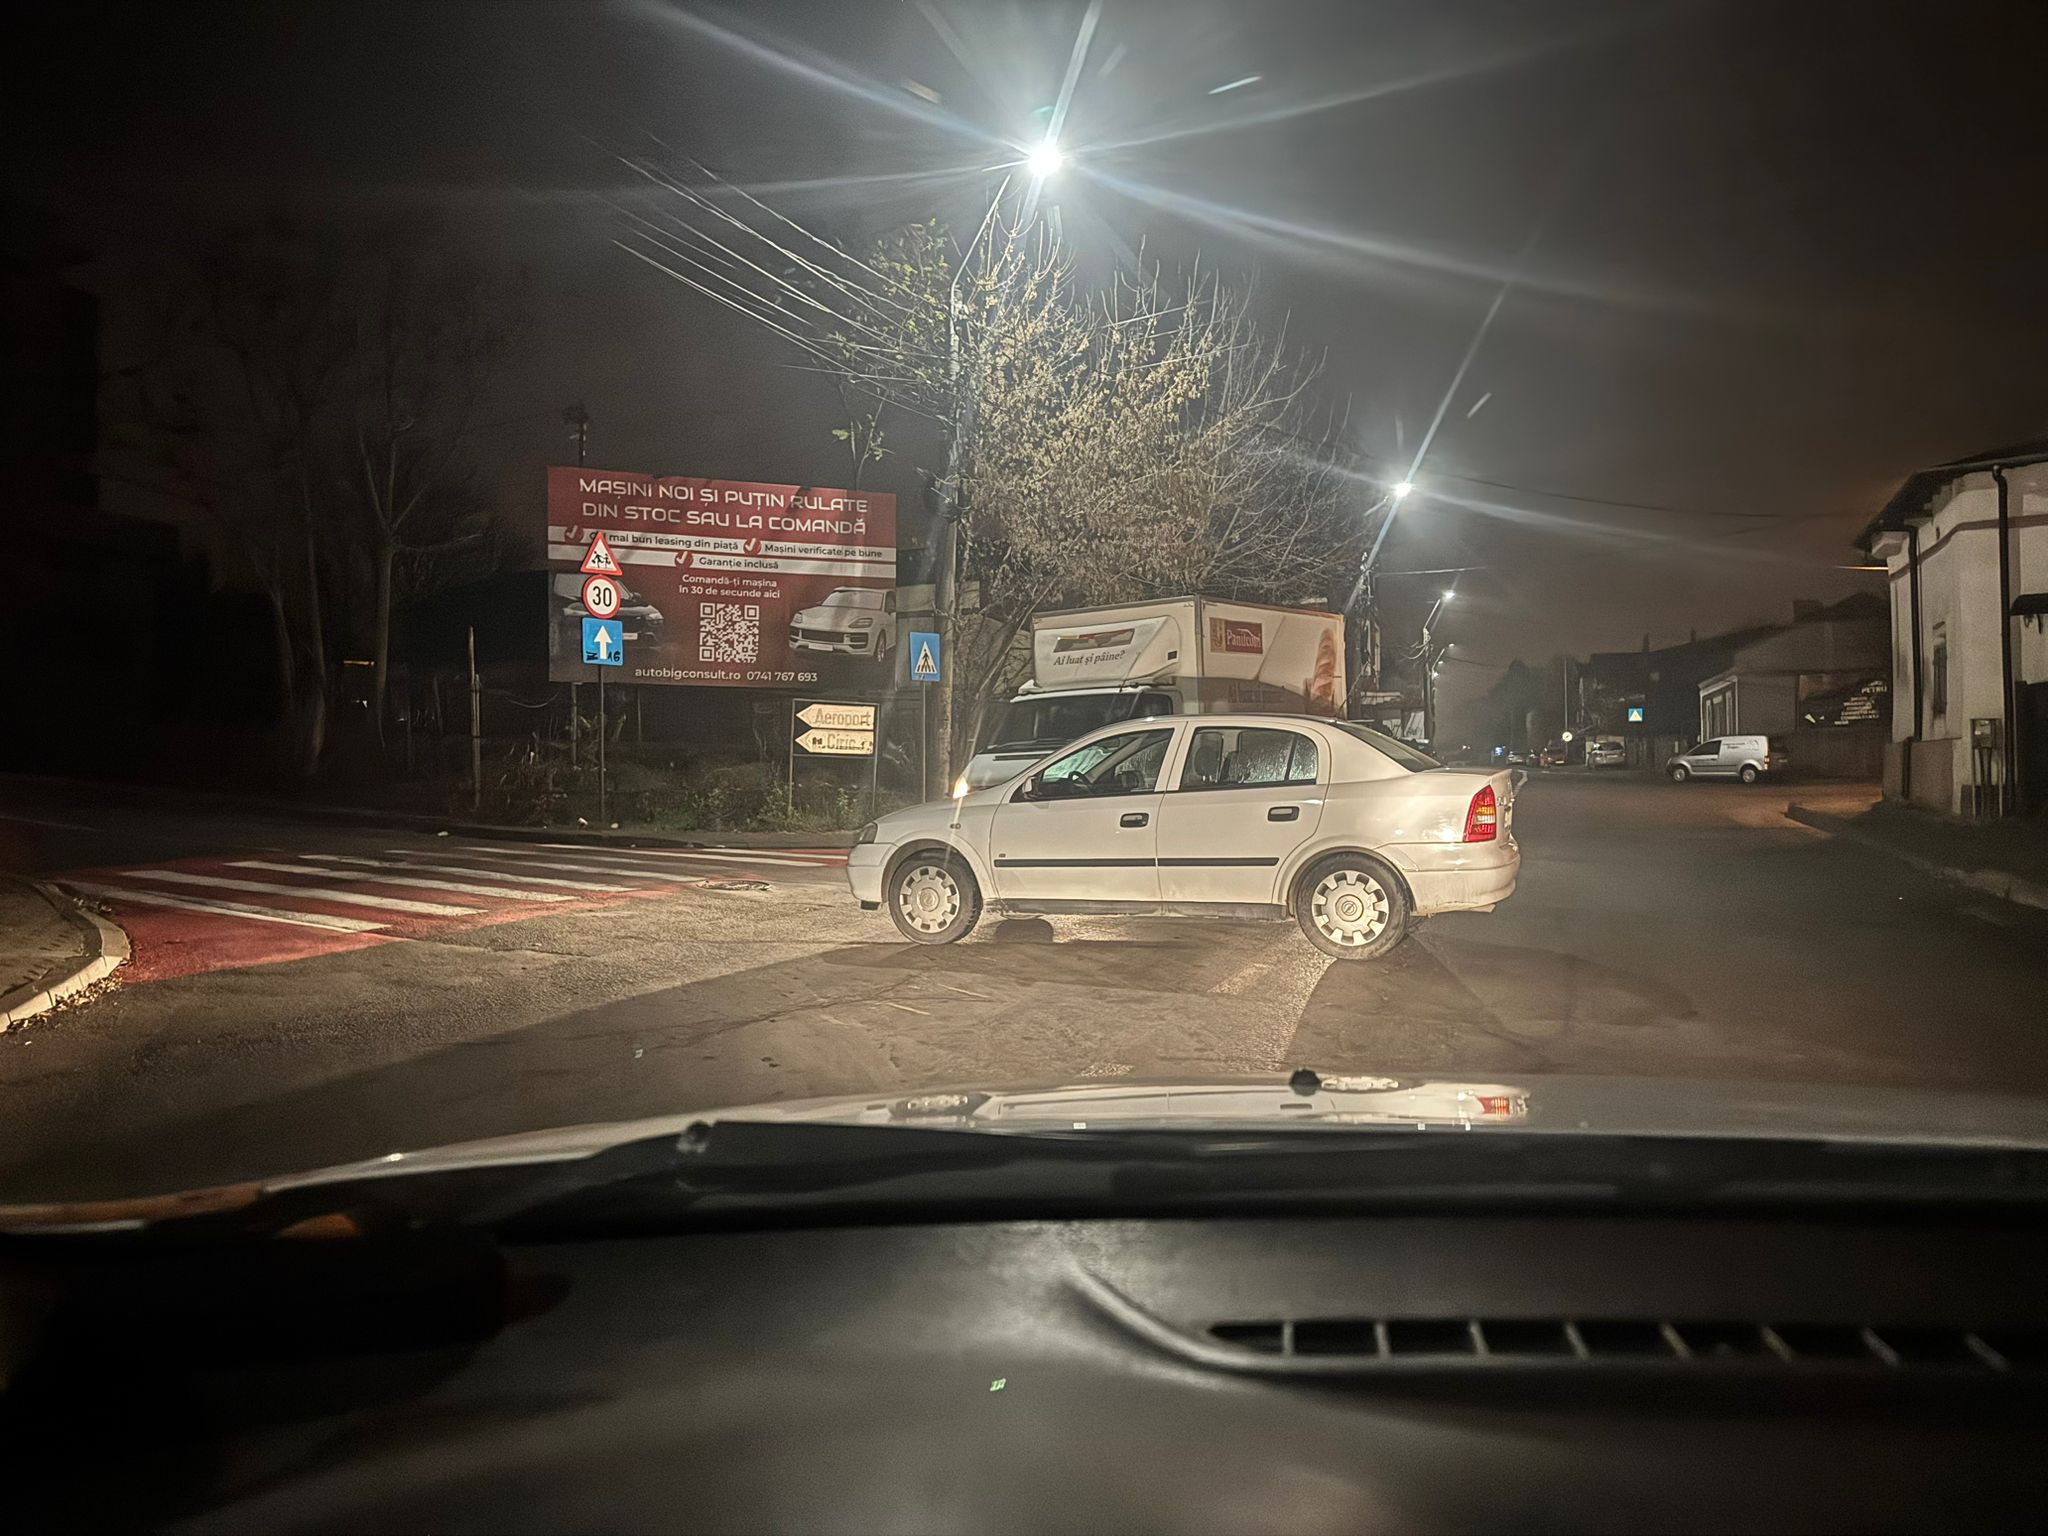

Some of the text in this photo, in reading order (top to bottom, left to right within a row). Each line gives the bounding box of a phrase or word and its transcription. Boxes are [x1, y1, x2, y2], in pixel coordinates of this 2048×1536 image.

[579, 478, 868, 512] MAȘINI NOI ȘI PUȚIN RULATE
[582, 502, 866, 535] DIN STOC SAU LA COMANDĂ
[609, 534, 629, 543] mai
[631, 533, 653, 545] bun
[654, 535, 692, 549] leasing
[694, 539, 711, 549] din
[713, 541, 739, 552] piață
[764, 544, 883, 559] Mașini verificate pe bune
[699, 556, 779, 570] Garanție inclusă
[742, 578, 777, 588] mașina
[592, 585, 613, 608] 30
[691, 585, 704, 595] 30
[705, 586, 719, 596] de
[720, 588, 762, 598] secunde
[763, 588, 781, 599] aici
[1053, 656, 1065, 666] Ai
[1066, 655, 1084, 665] luat
[1093, 649, 1126, 664] pâine?
[634, 667, 818, 682] autobigconsult.ro 0741 767 693
[812, 708, 871, 726] Aeroport
